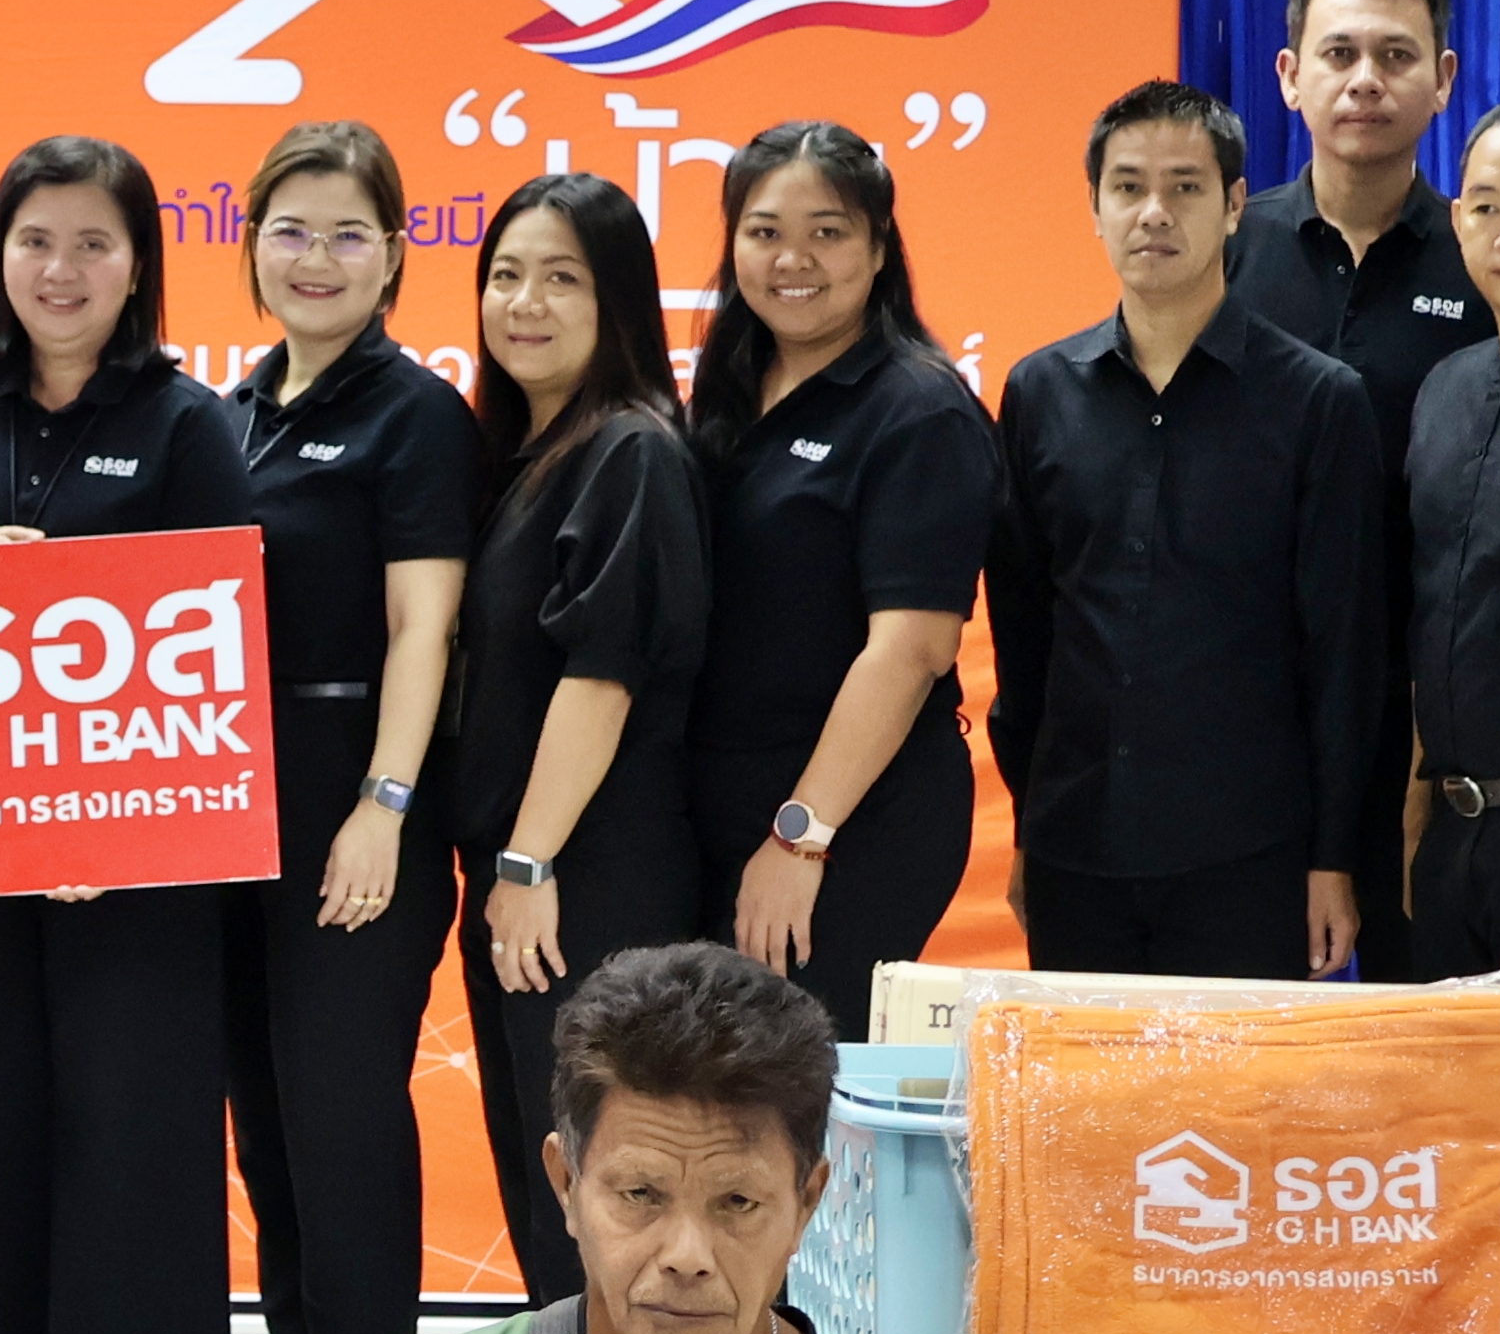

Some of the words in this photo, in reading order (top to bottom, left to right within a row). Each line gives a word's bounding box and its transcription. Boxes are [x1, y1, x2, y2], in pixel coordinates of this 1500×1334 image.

[10, 712, 59, 768] H
[80, 700, 252, 764] BANK
[1273, 1148, 1438, 1212] ธอส
[1351, 1213, 1439, 1244] BANK
